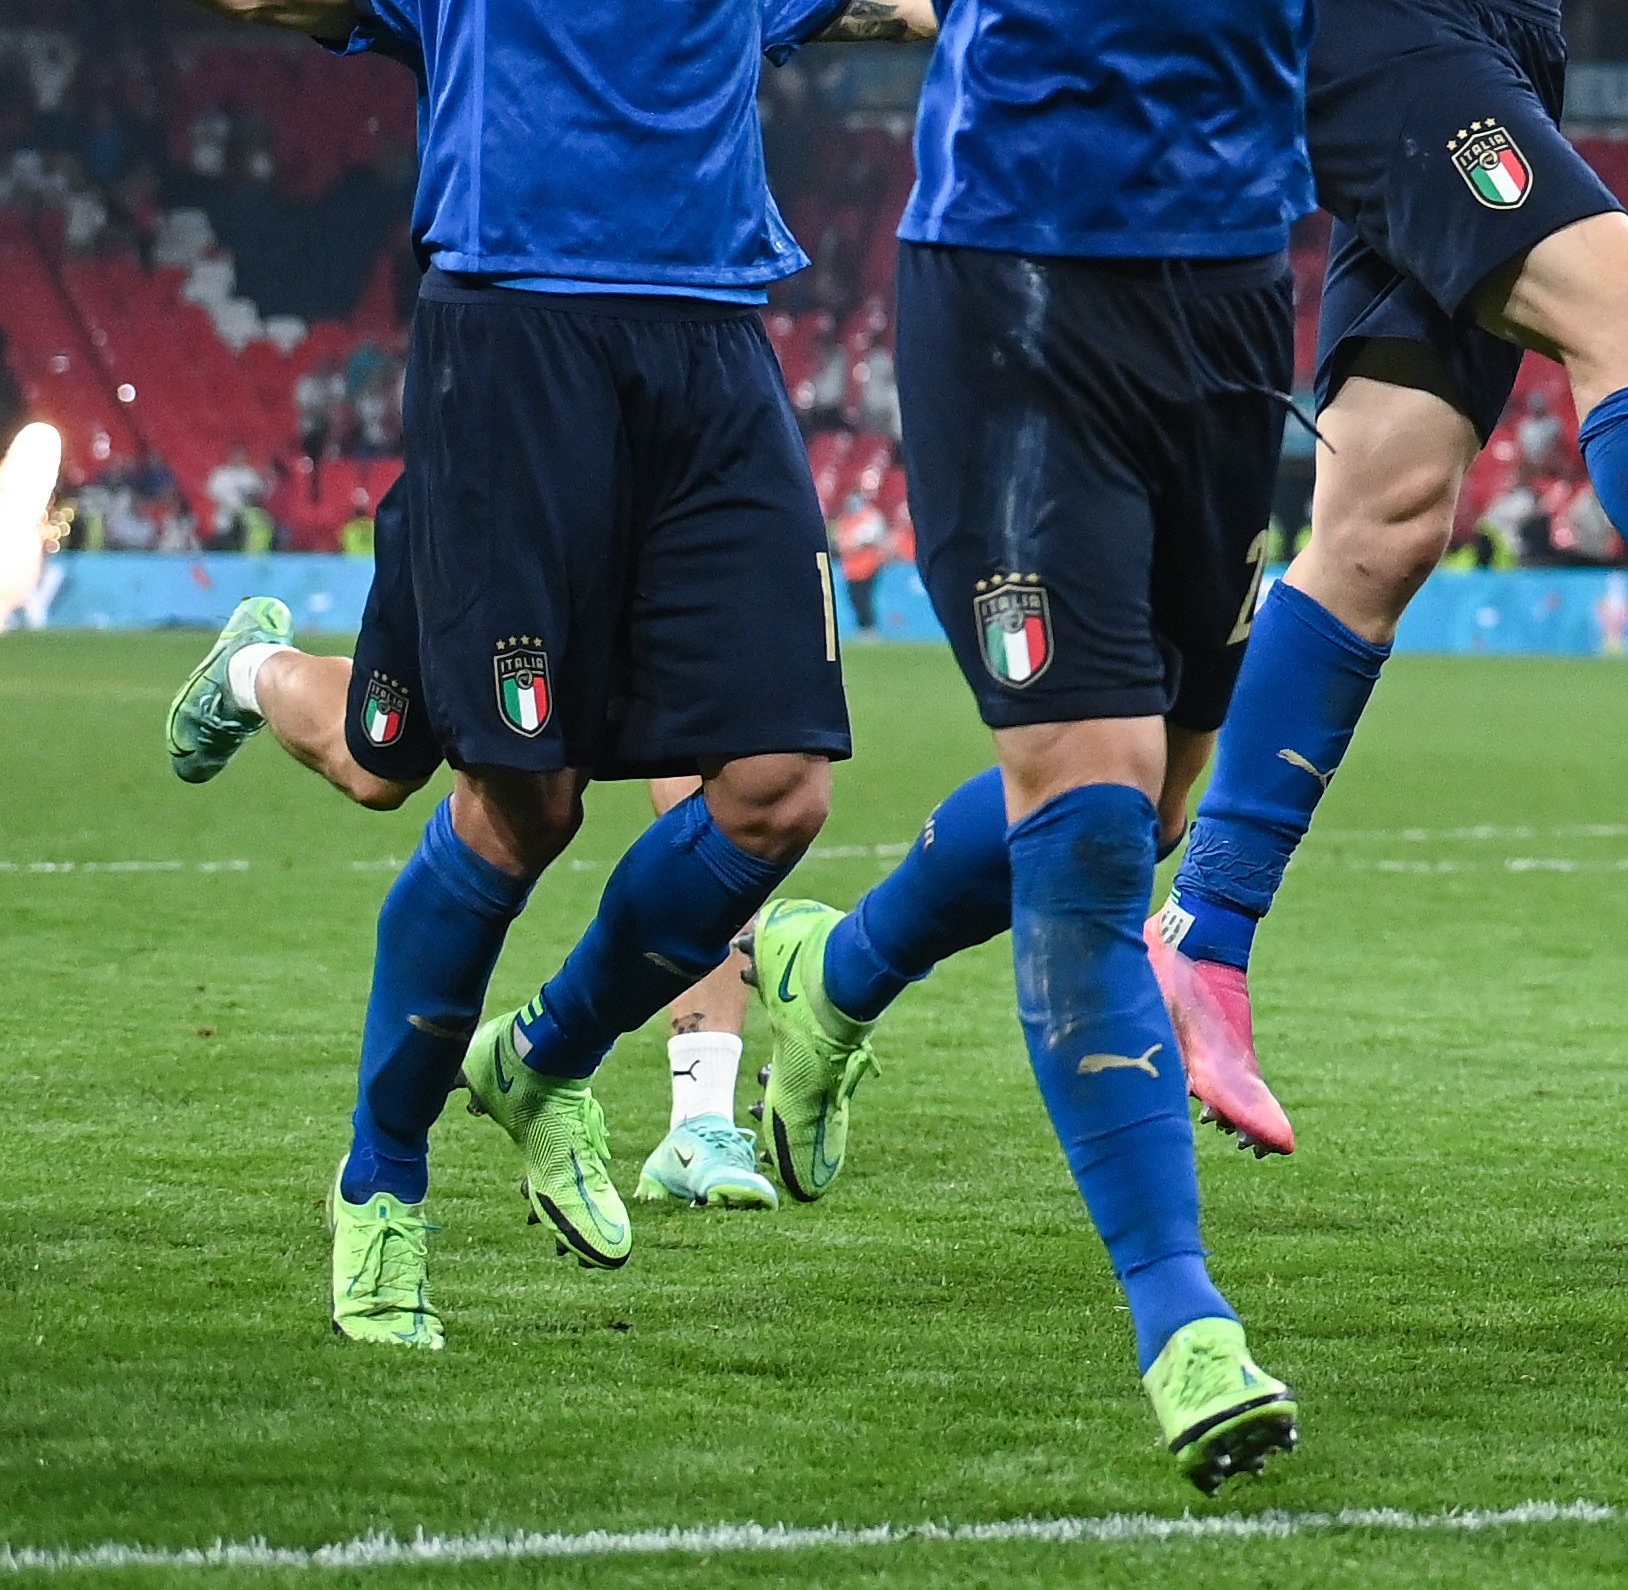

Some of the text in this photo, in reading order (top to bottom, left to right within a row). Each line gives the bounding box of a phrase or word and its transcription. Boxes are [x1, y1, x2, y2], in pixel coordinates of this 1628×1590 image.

[1459, 133, 1506, 167] ITALIA
[500, 657, 544, 673] ITALIA
[370, 685, 403, 709] ITALIA
